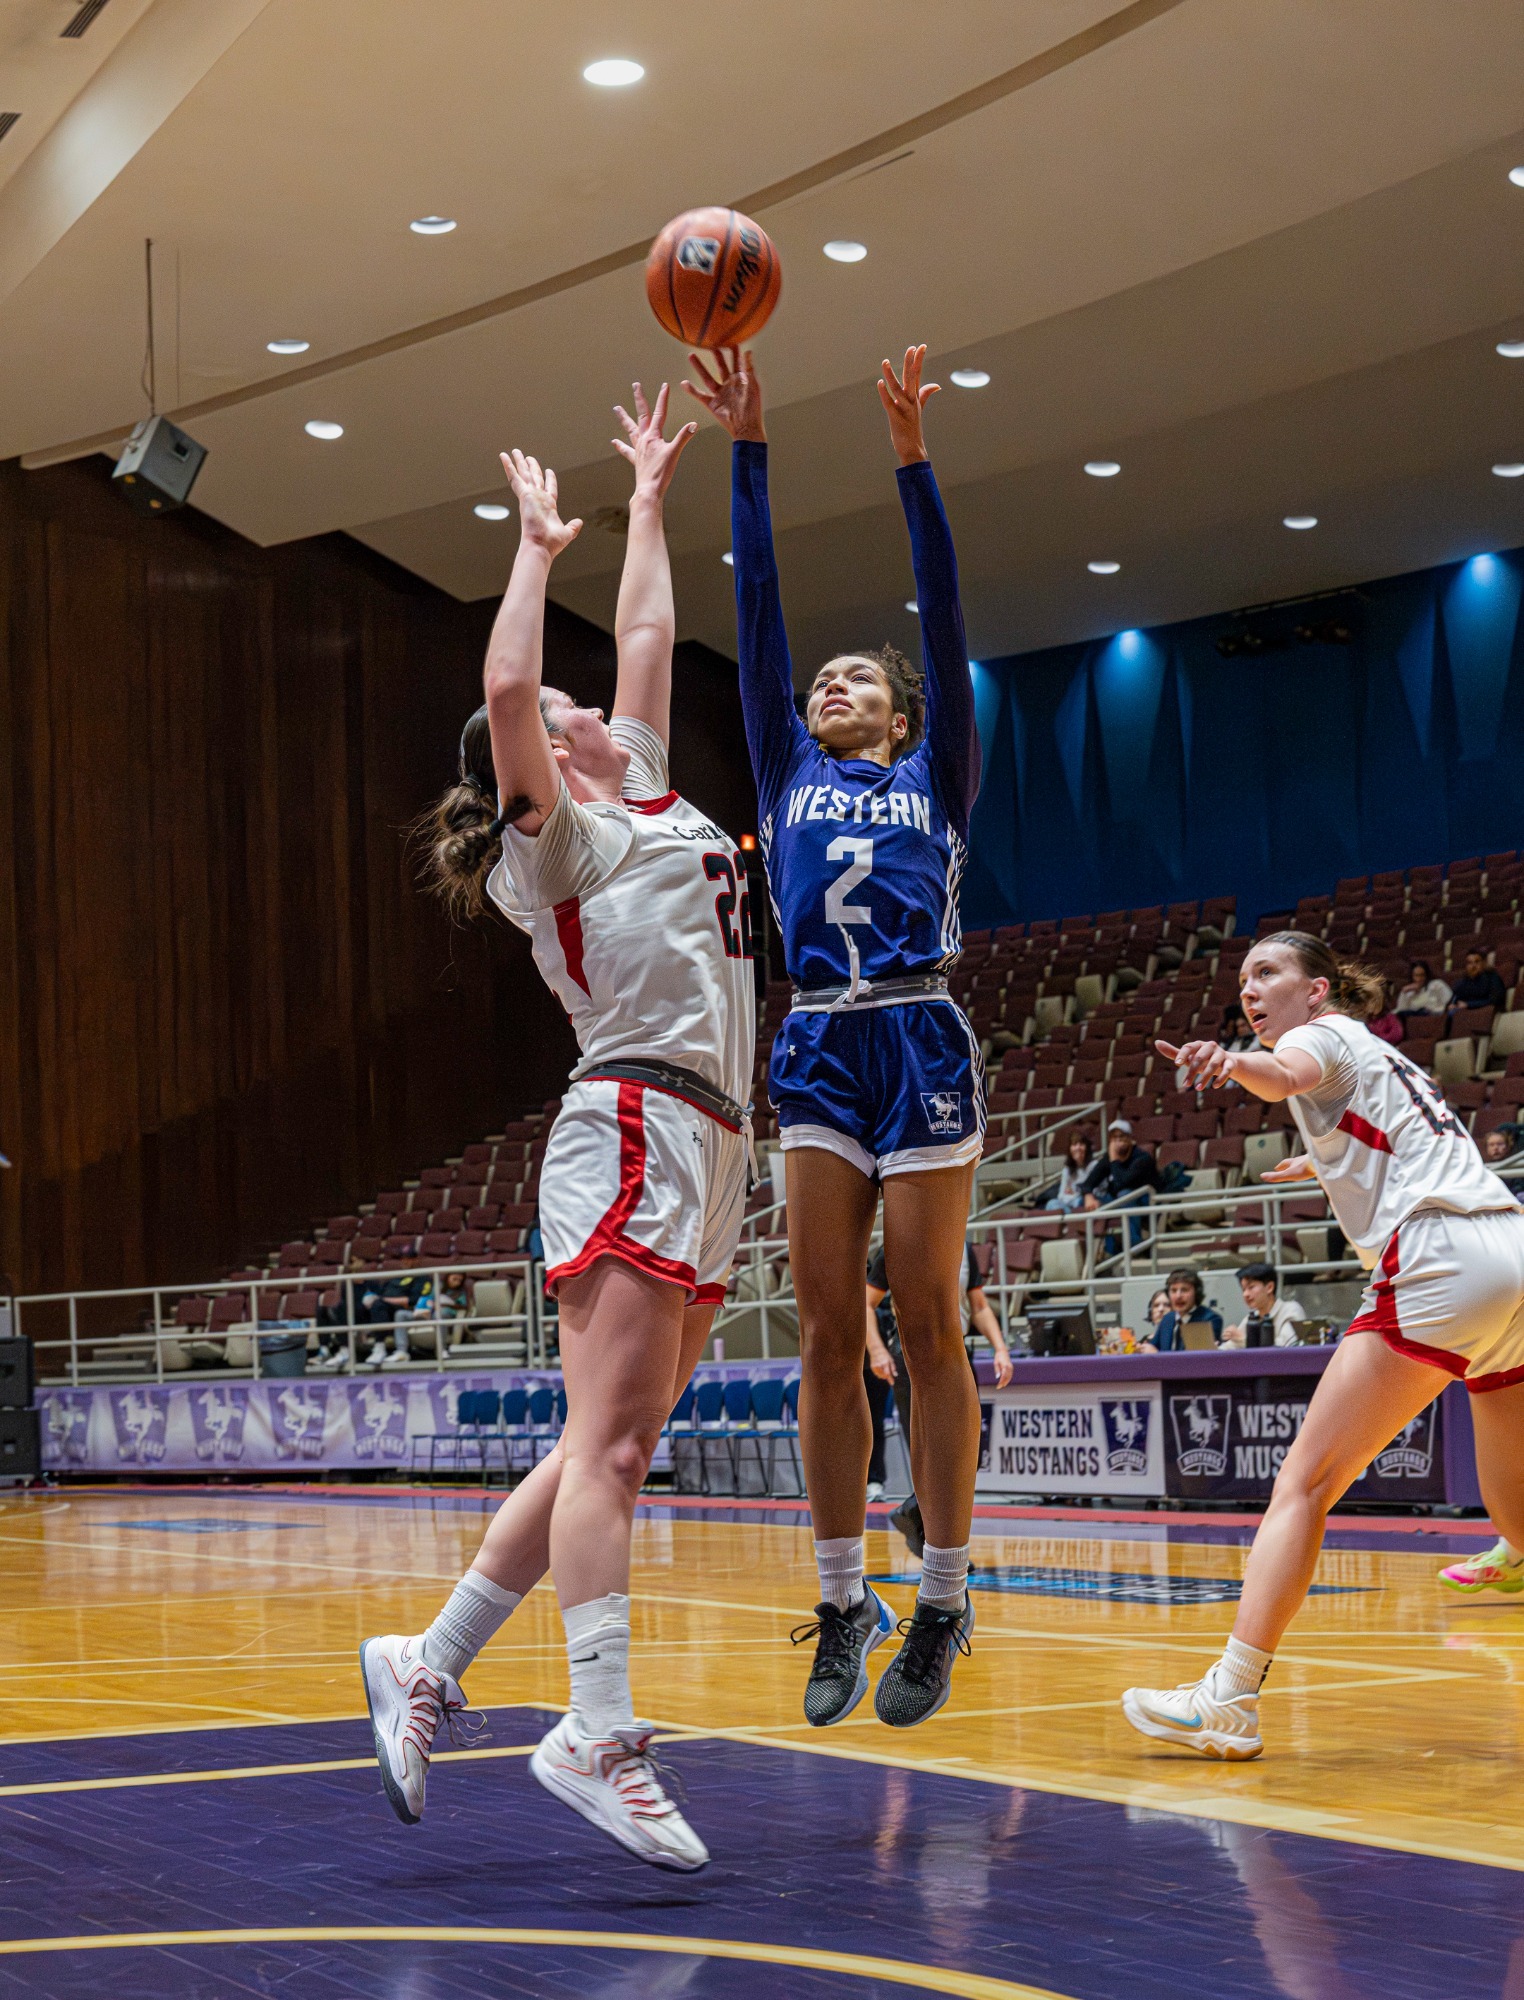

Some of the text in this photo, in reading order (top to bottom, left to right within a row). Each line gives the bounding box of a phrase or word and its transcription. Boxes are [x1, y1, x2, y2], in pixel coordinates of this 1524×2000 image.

[786, 785, 931, 835] WESTERN
[825, 835, 874, 925] 2
[1001, 1408, 1093, 1439] WESTERN
[999, 1446, 1100, 1477] MUSTANGS
